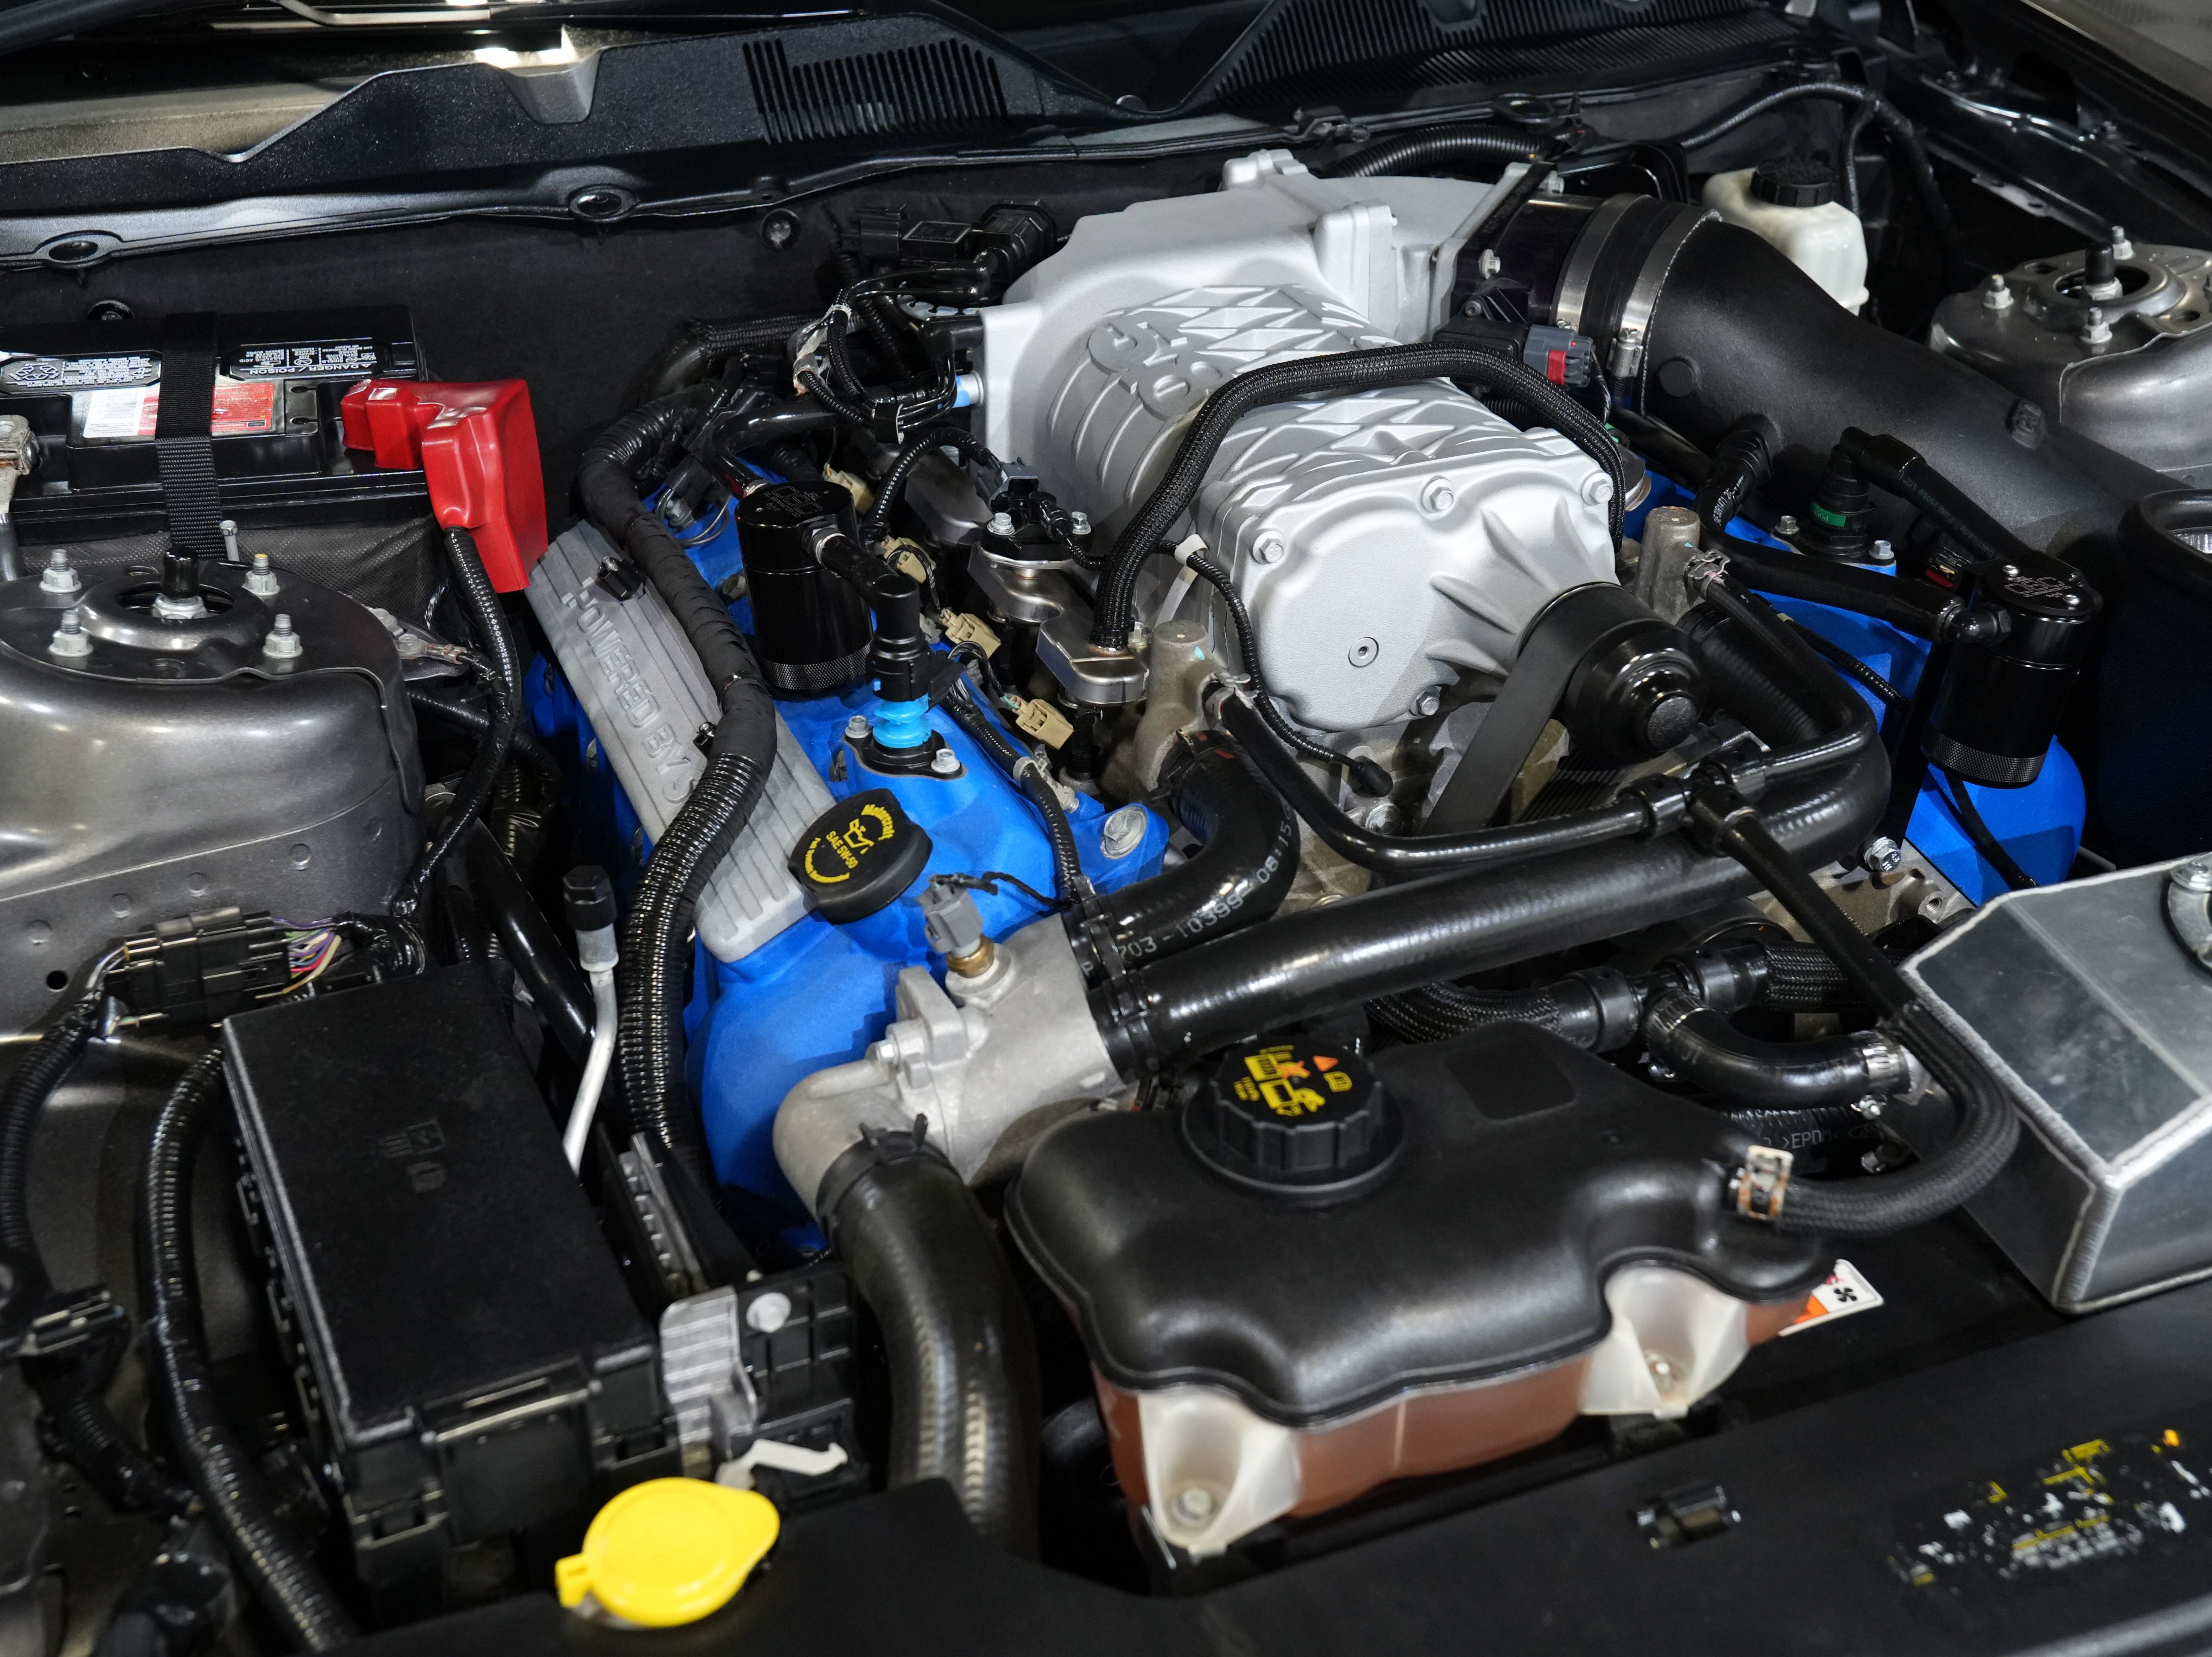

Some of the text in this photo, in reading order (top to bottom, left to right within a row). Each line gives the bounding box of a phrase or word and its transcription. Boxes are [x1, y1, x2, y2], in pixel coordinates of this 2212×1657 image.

[771, 486, 822, 515] OSC
[2004, 577, 2065, 594] OSC
[561, 576, 661, 729] POWERED
[641, 721, 692, 774] BY
[826, 830, 844, 850] SAE
[837, 845, 859, 869] 5W-50
